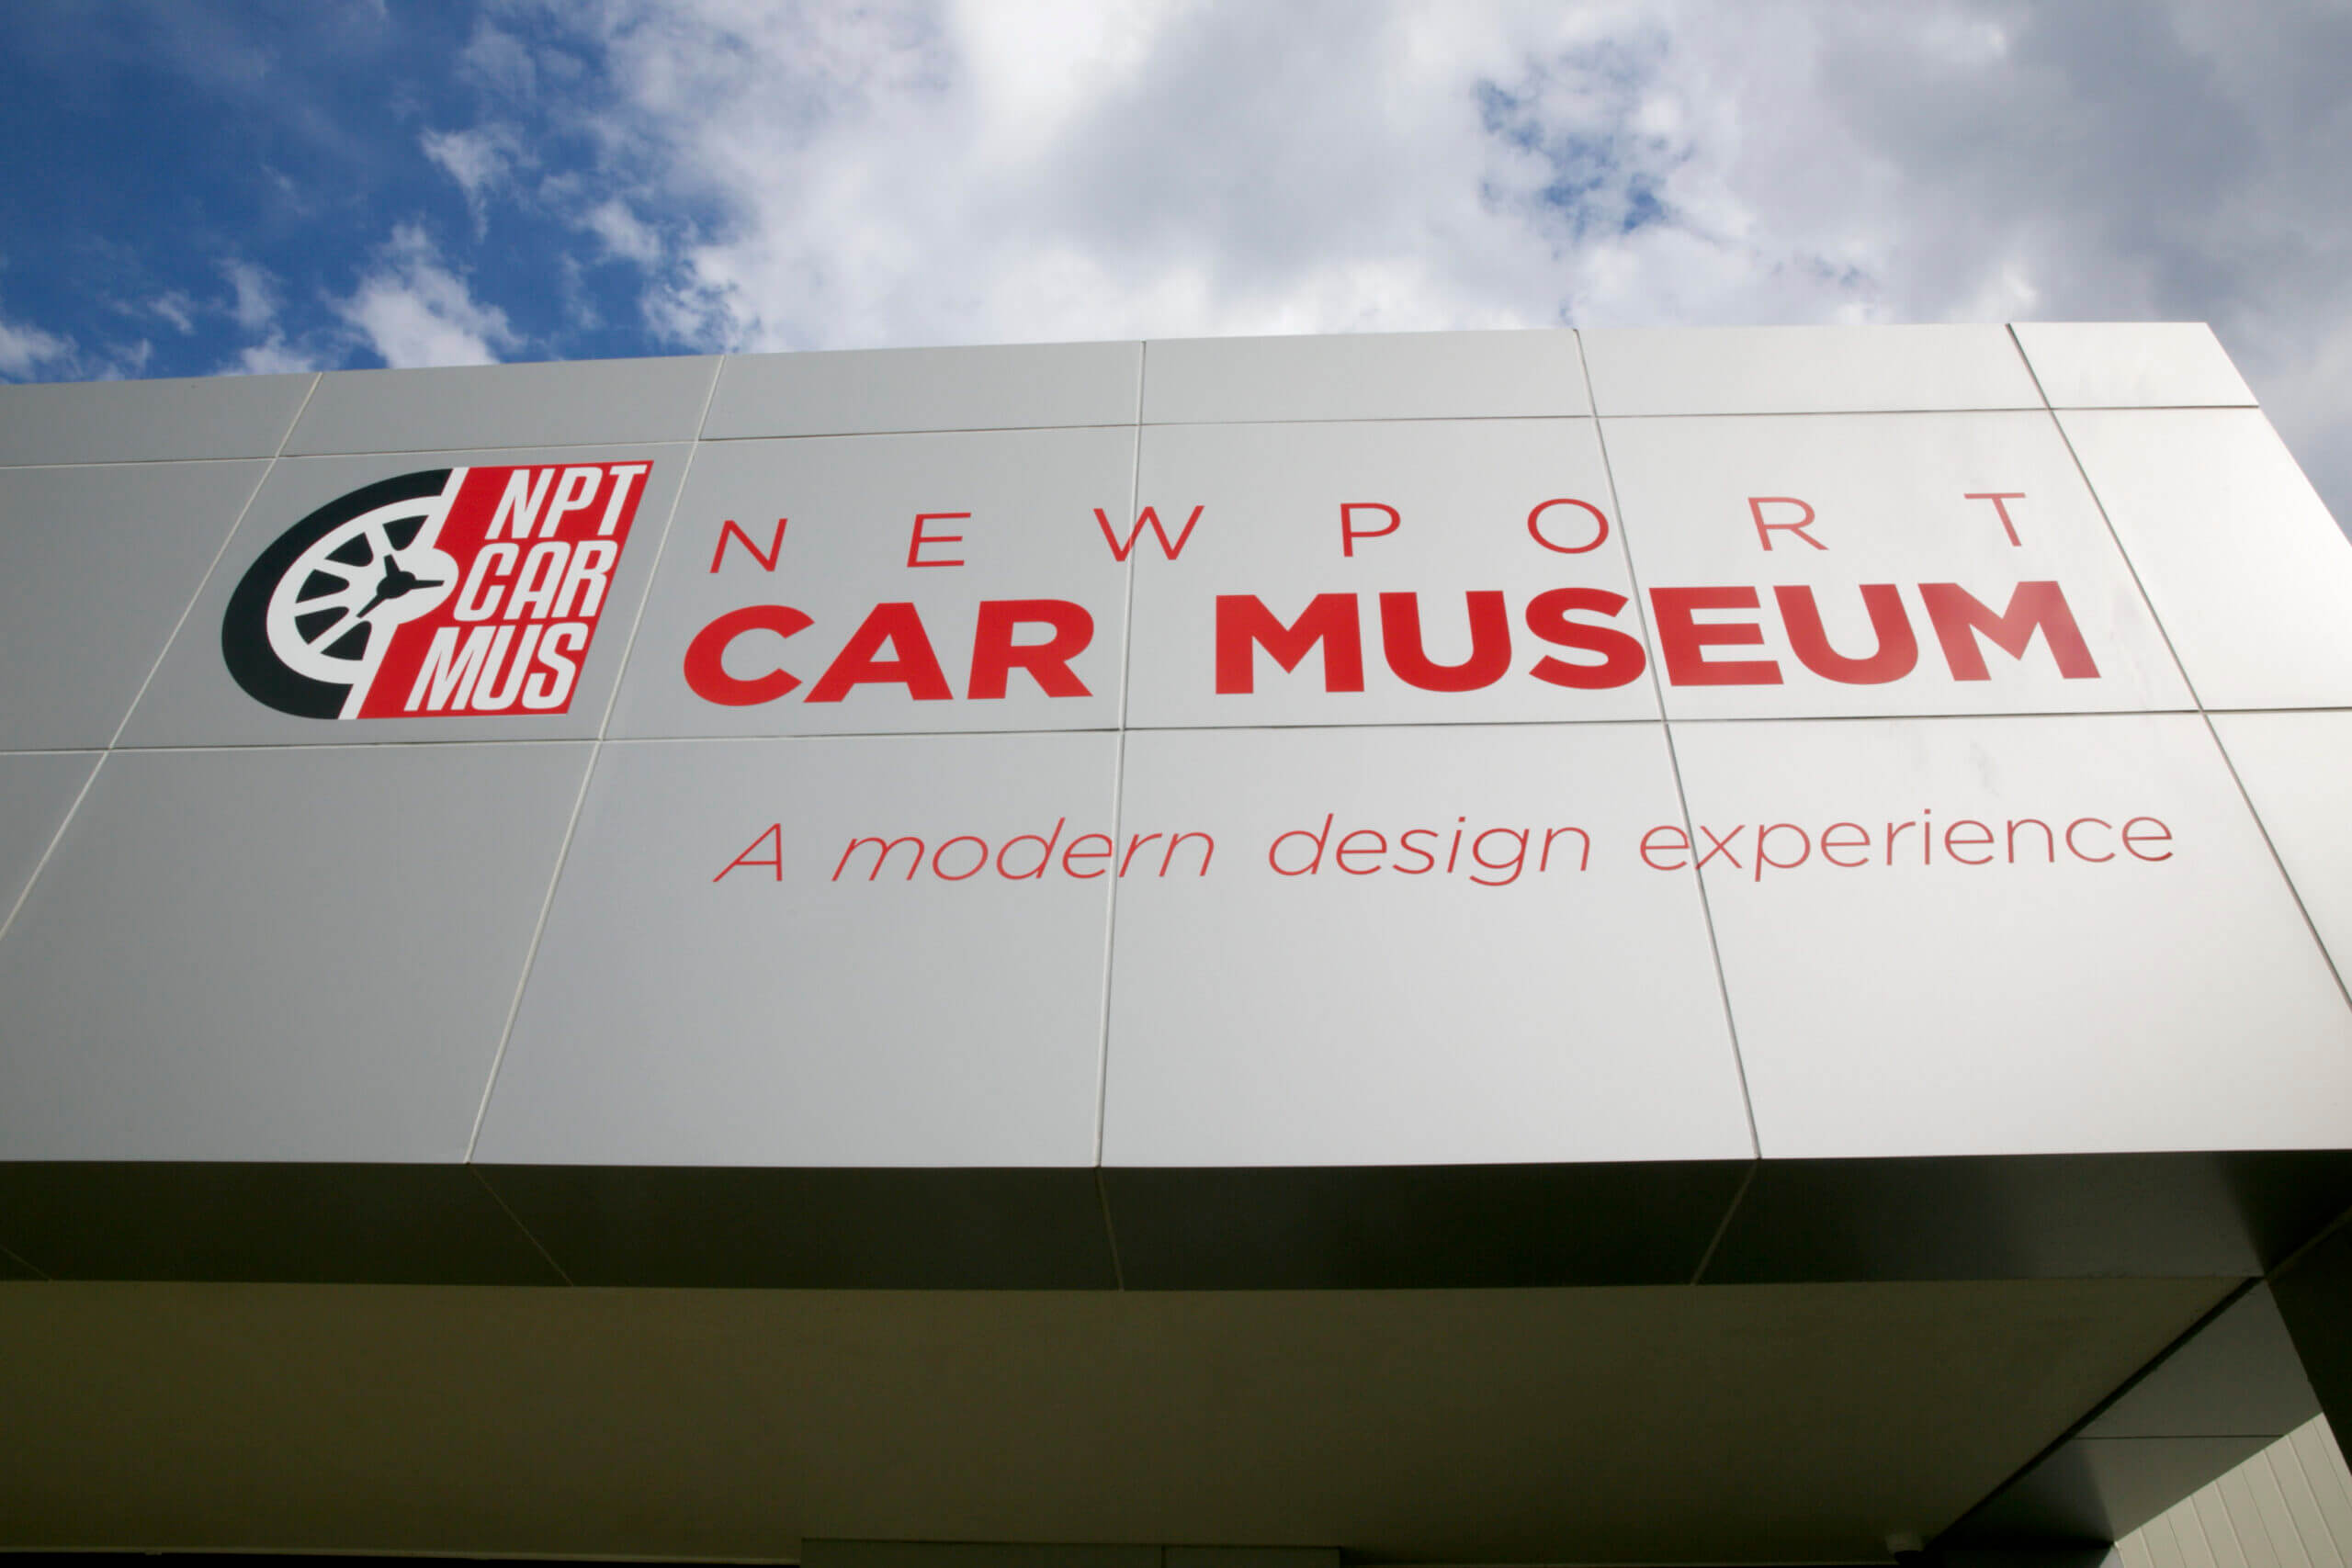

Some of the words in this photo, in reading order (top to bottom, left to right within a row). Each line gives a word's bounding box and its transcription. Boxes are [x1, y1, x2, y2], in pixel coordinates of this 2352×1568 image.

[484, 465, 648, 540] NPT
[709, 492, 2025, 574] NEWPORT
[453, 540, 617, 622] CAR
[403, 622, 589, 713] MUS
[683, 599, 1095, 707] CAR
[1214, 581, 2102, 695] MUSEUM
[712, 823, 784, 883] A
[831, 817, 1216, 882] modern
[1269, 813, 1590, 886] design
[1640, 807, 2173, 883] experience
